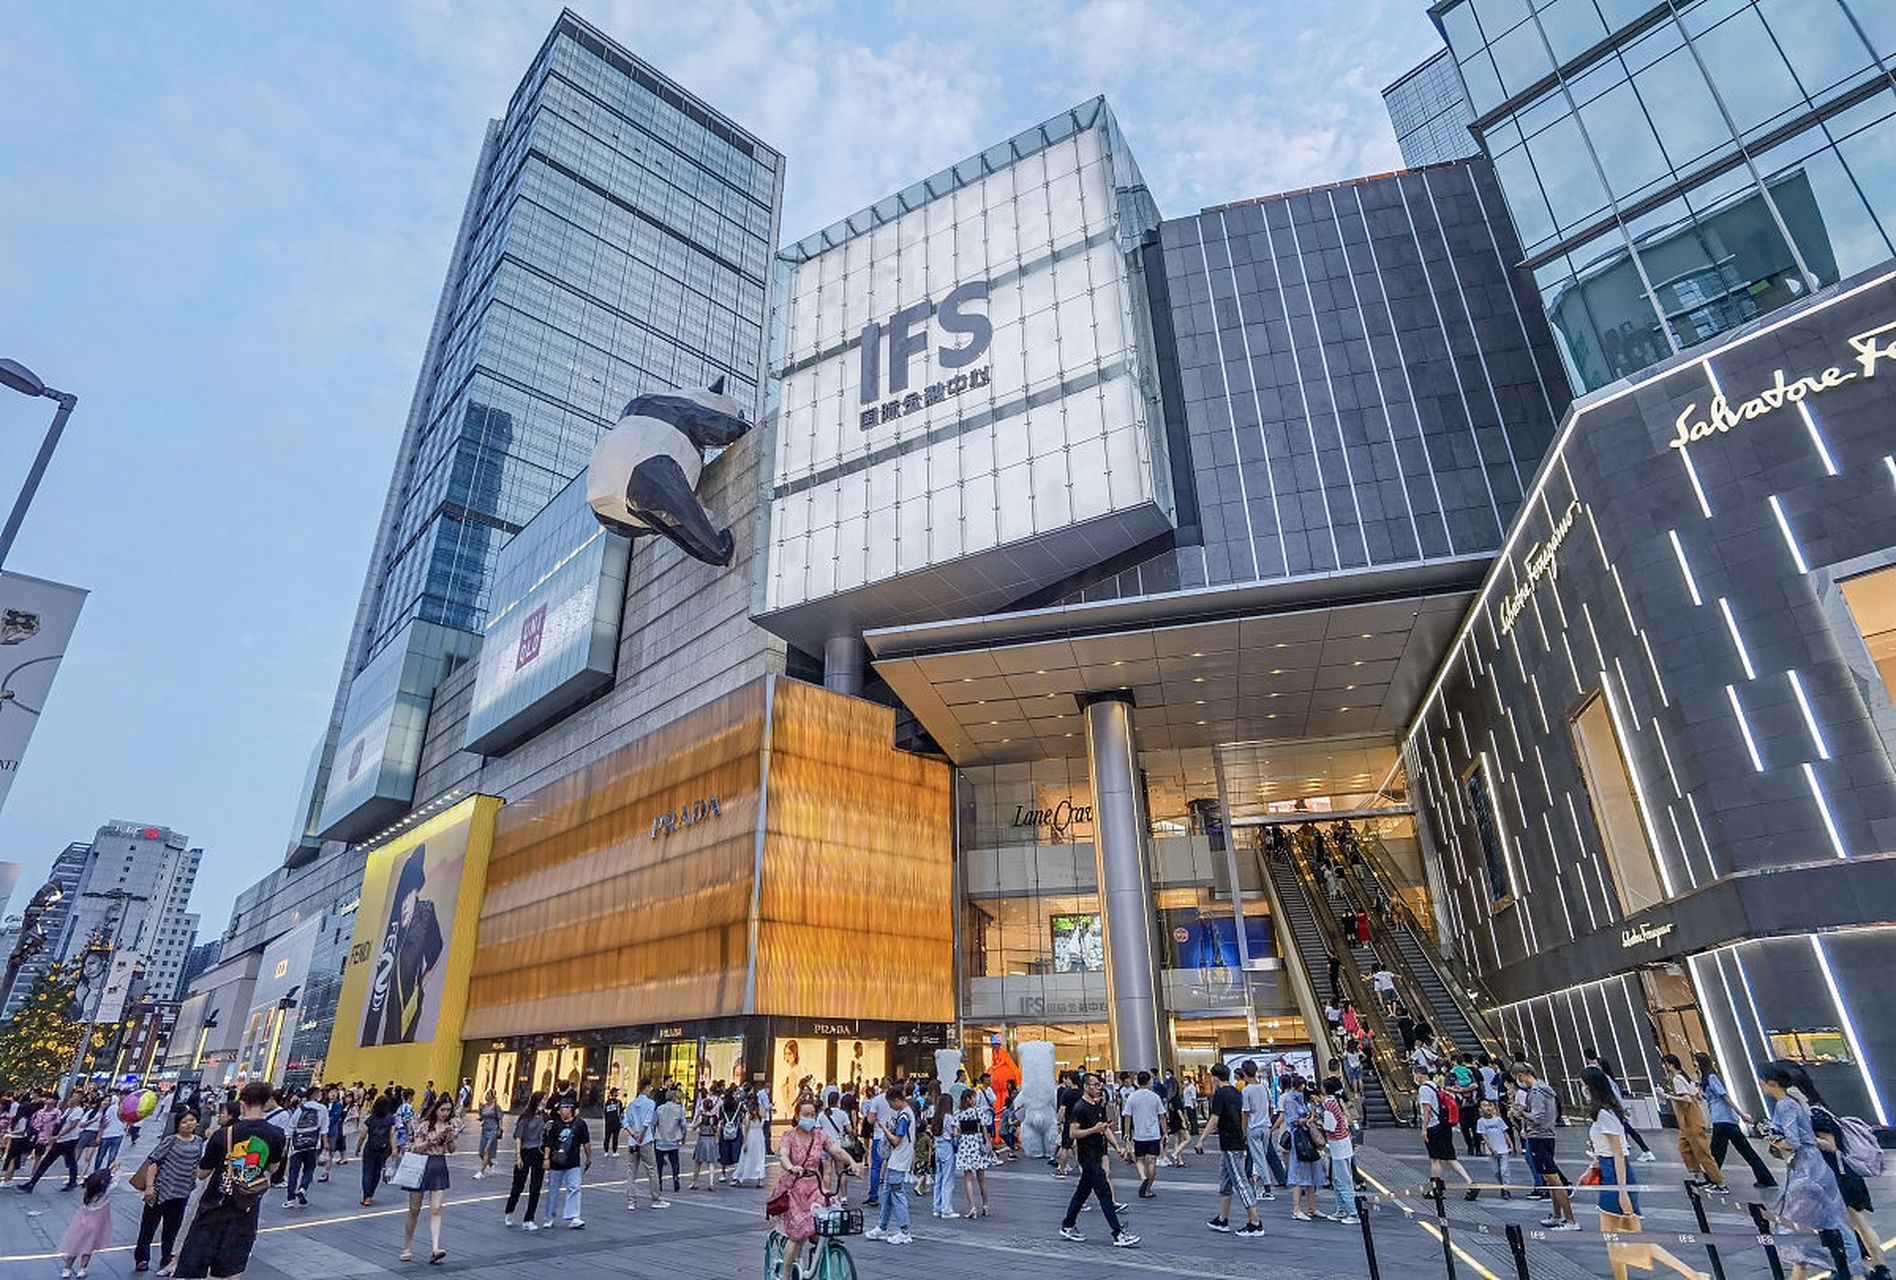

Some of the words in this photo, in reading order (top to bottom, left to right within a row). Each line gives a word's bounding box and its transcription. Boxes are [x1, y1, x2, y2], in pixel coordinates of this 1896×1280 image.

[861, 281, 993, 405] IFS
[1670, 368, 1857, 448] Salvatore
[651, 795, 720, 839] PRADA
[1012, 806, 1053, 827] Lane
[814, 1023, 850, 1034] PRADA
